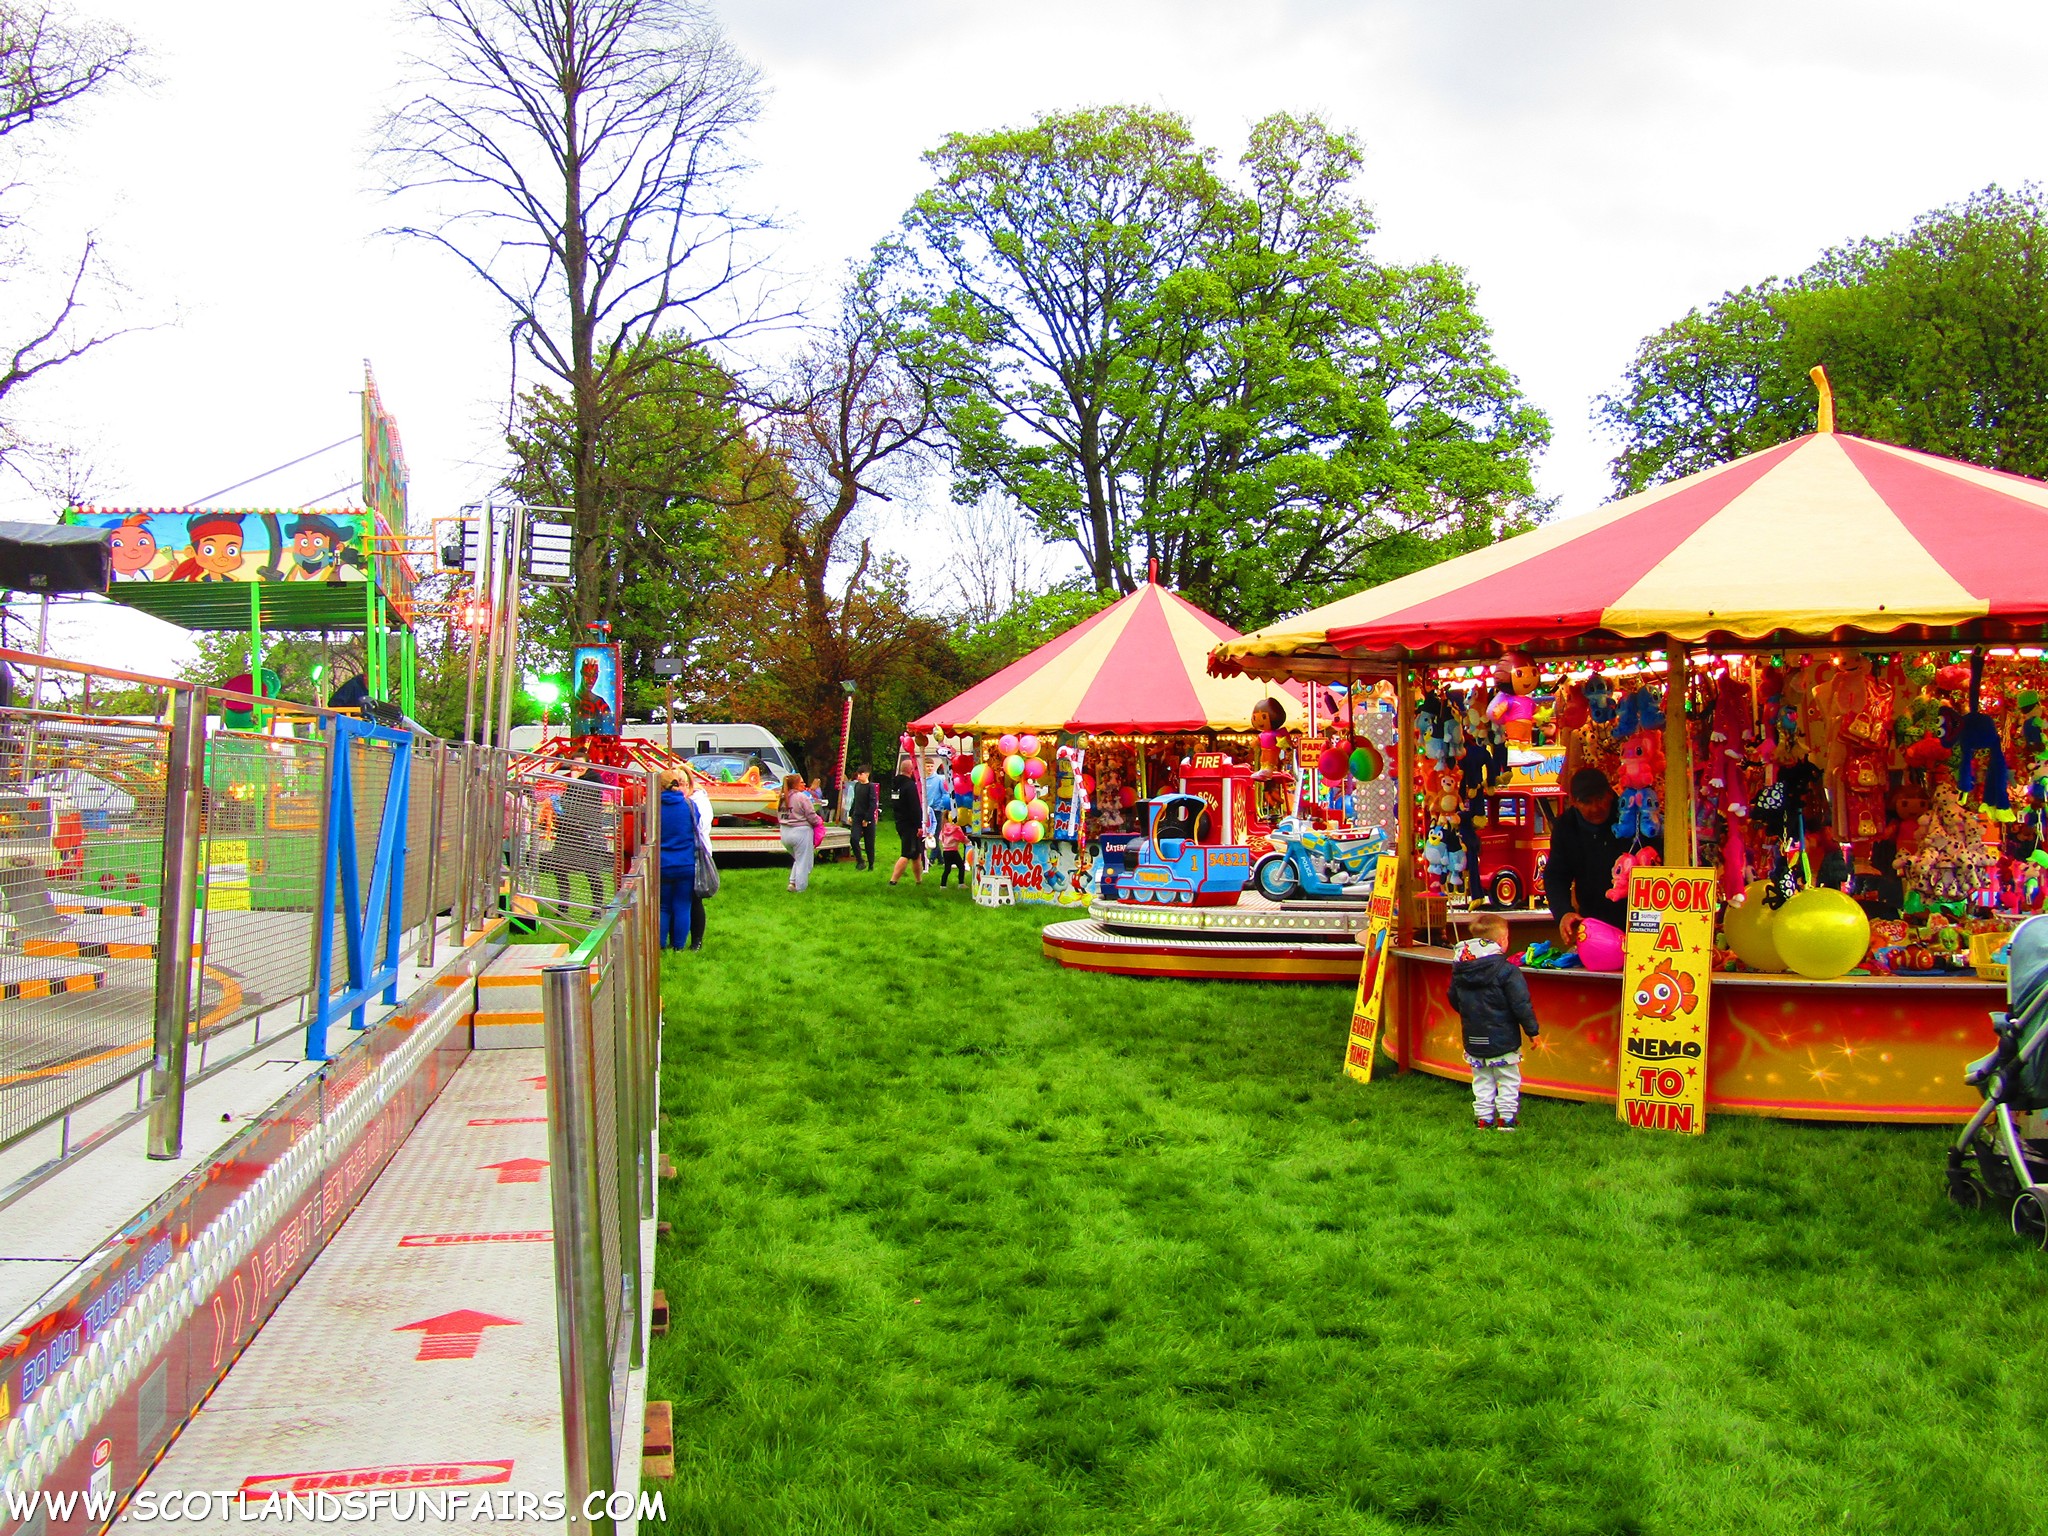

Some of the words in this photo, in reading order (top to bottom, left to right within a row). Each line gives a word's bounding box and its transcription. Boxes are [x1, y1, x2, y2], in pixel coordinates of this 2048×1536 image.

[1195, 756, 1220, 768] FIRE
[1302, 754, 1320, 762] £2.5
[1057, 801, 1072, 814] An
[1197, 791, 1219, 811] SCUE
[1054, 819, 1080, 832] Pri
[991, 842, 1034, 870] Hook
[1191, 855, 1198, 871] 1
[1209, 853, 1248, 867] 54321
[1300, 856, 1313, 878] POLICE
[1381, 865, 1389, 887] A
[1632, 877, 1713, 912] HOOK
[1372, 895, 1392, 920] PRIZE
[1653, 923, 1683, 952] A
[1351, 1013, 1377, 1041] EVERY
[1627, 1037, 1702, 1058] NEMO
[1636, 1066, 1685, 1098] TO
[1625, 1098, 1694, 1133] WIN
[264, 1201, 310, 1298] FLIGHT
[314, 1166, 344, 1237] DECK
[433, 1232, 545, 1244] DANGER
[23, 1349, 48, 1401] DO
[50, 1318, 82, 1375] NOT
[84, 1275, 126, 1341] TOUCH
[127, 1231, 174, 1301] PLASMA
[291, 1467, 462, 1491] DANGER
